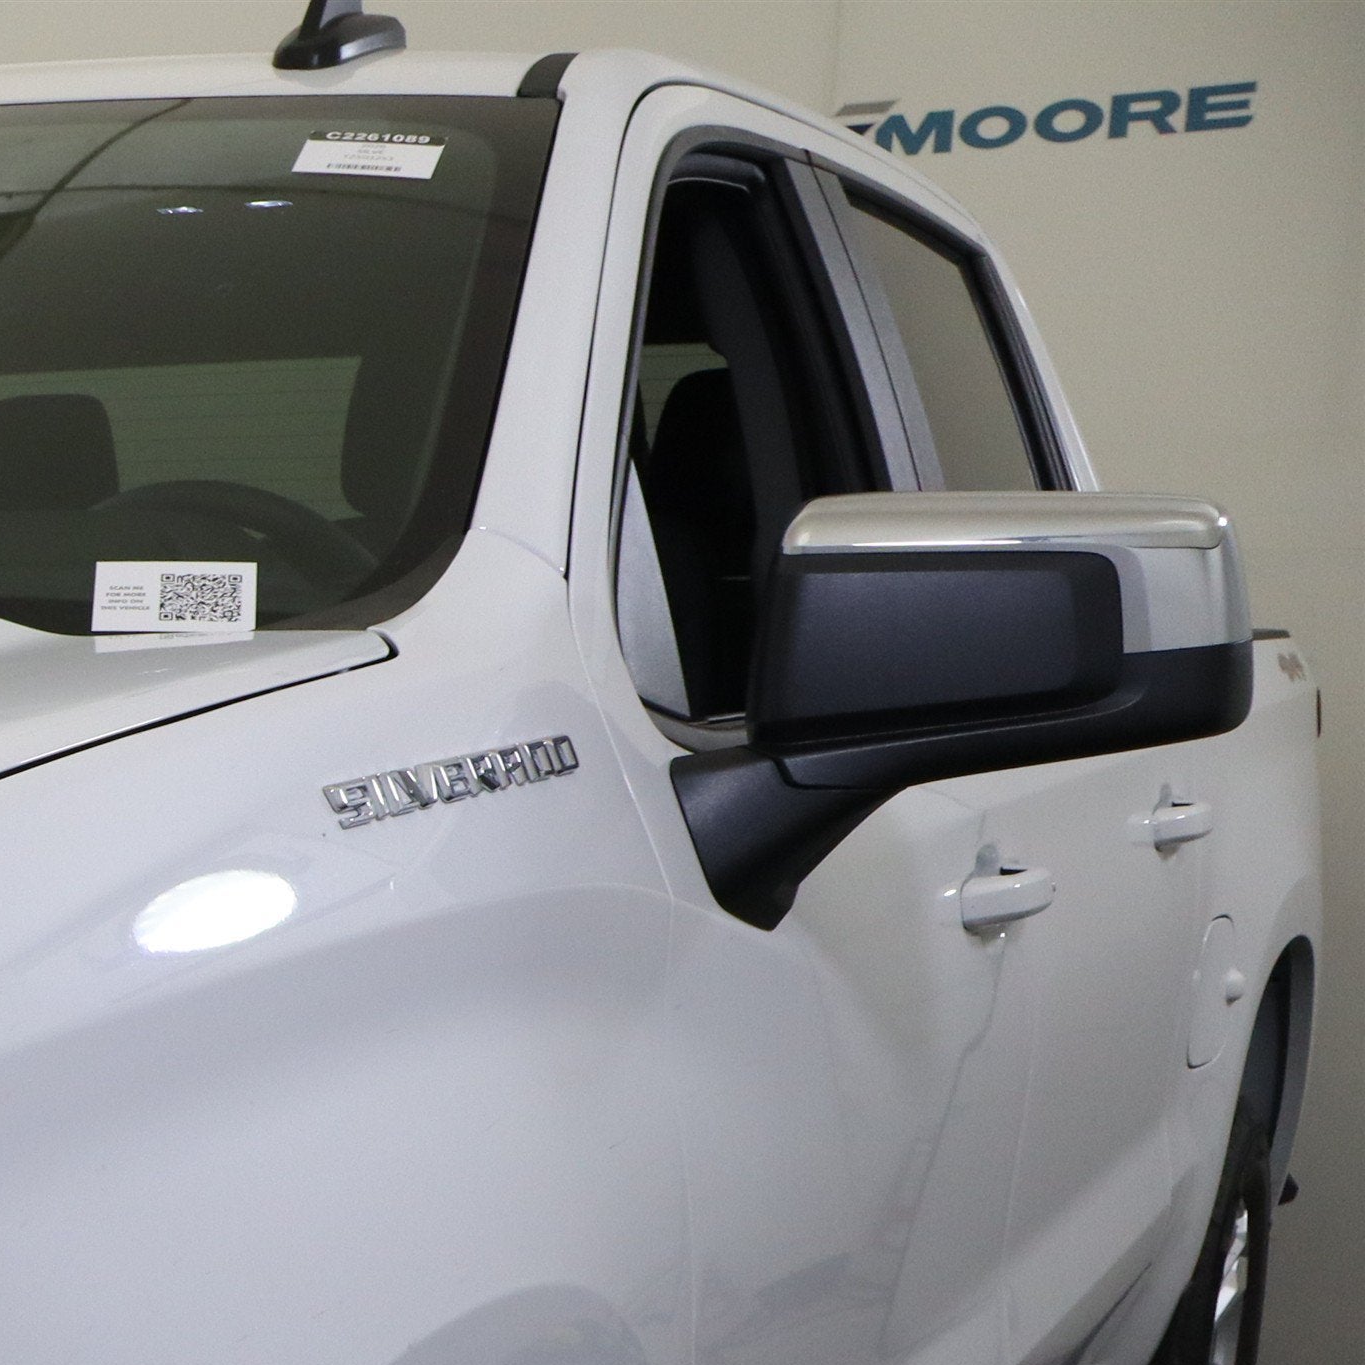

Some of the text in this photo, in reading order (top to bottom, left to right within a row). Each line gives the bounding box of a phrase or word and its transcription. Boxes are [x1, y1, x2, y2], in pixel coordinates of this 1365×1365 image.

[326, 130, 431, 144] C2261089
[876, 81, 1257, 155] MOORE
[322, 734, 580, 830] SILVERADO
